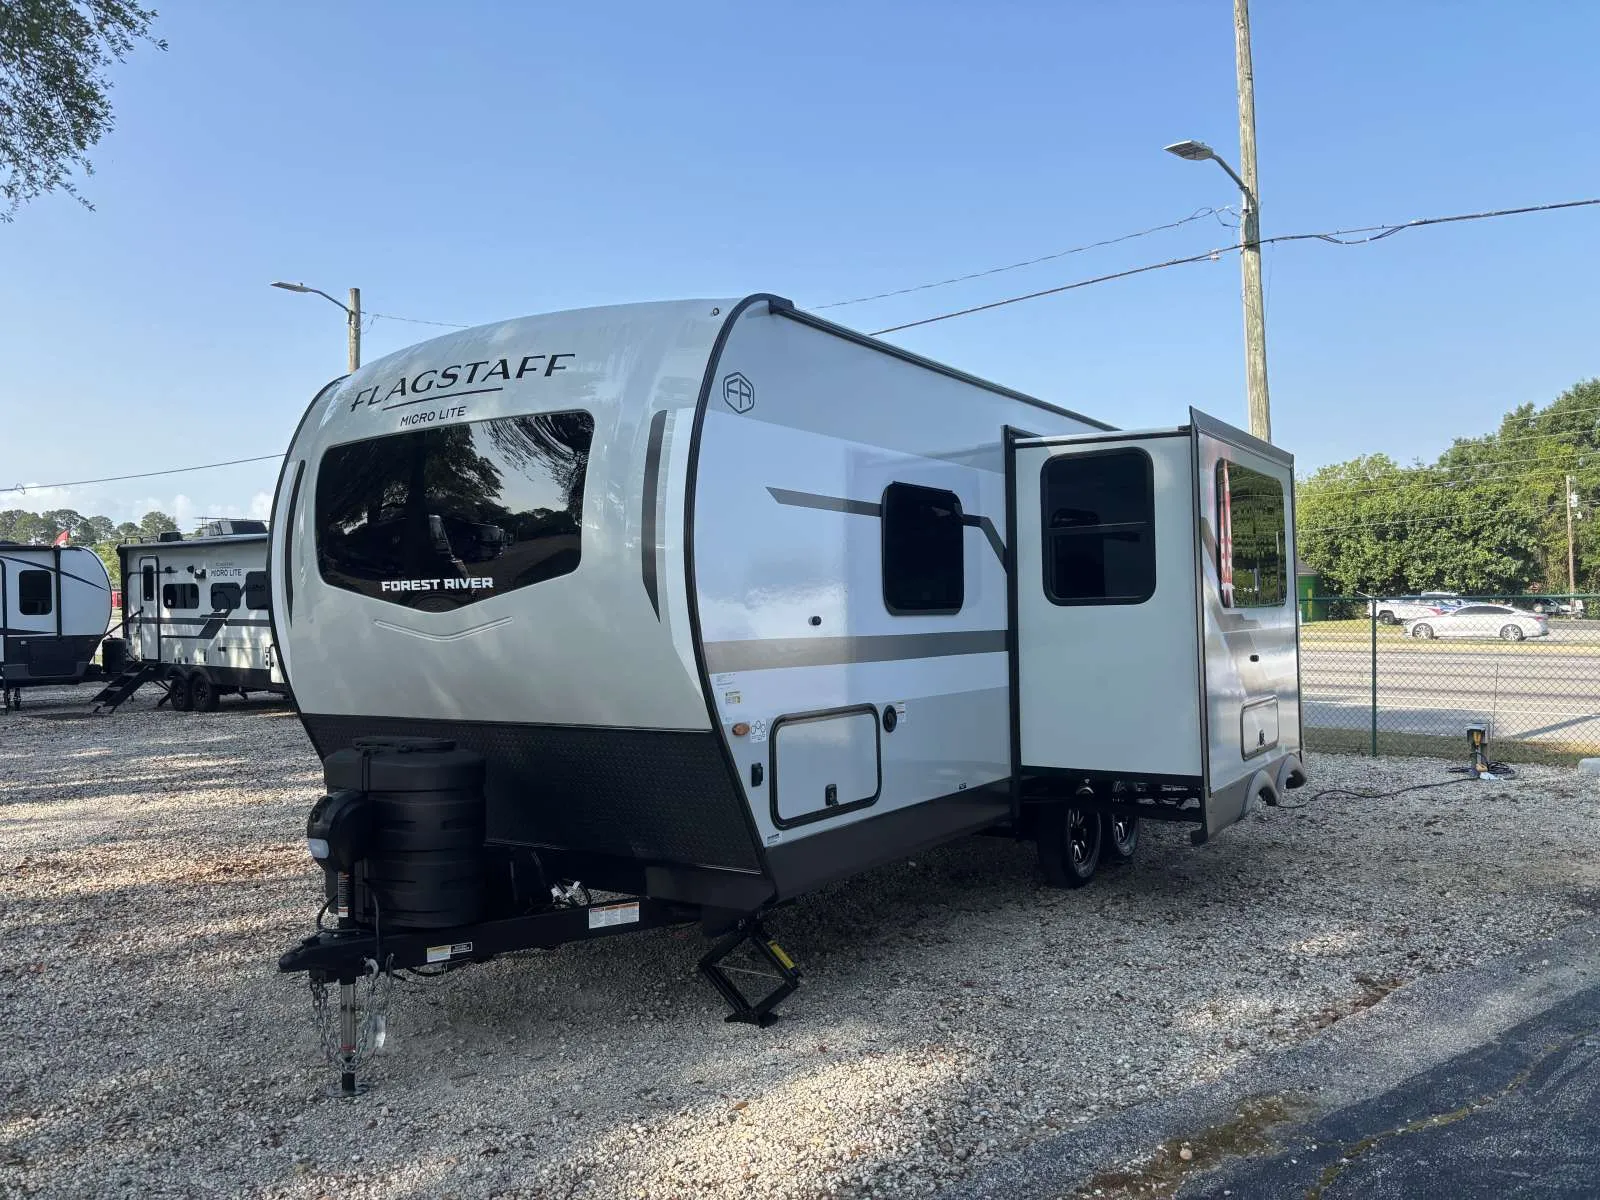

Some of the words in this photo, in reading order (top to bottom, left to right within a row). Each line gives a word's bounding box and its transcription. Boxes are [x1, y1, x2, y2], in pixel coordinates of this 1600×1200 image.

[351, 353, 576, 412] FLAGSTAFF
[400, 411, 436, 427] MICRO
[439, 405, 467, 420] LITE
[229, 568, 242, 577] LITE
[381, 579, 441, 592] FOREST
[443, 577, 494, 590] RIVER
